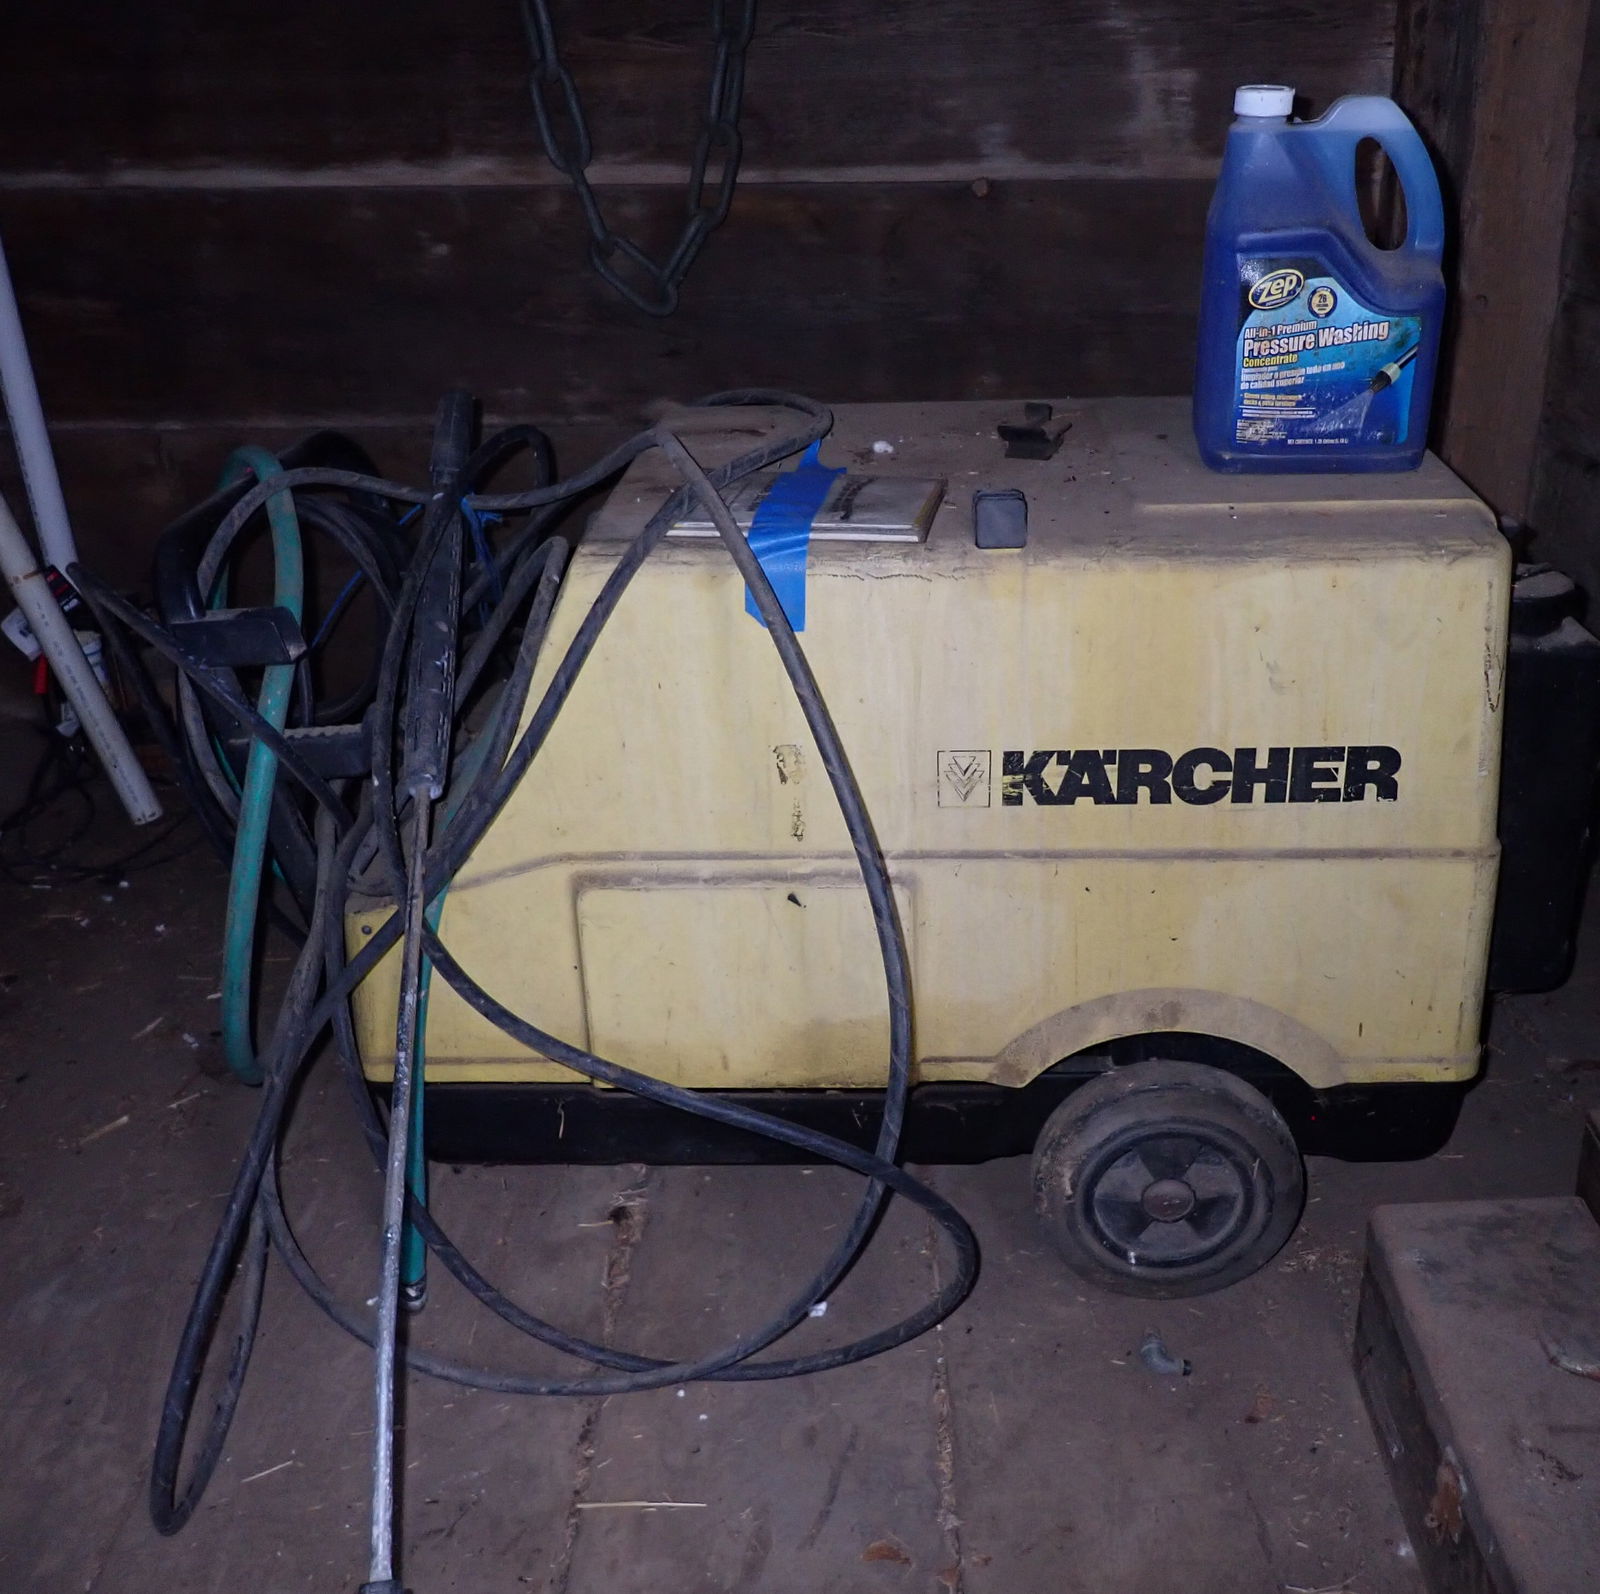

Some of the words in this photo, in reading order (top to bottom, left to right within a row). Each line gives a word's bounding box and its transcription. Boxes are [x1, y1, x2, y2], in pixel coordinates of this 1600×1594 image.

[1243, 333, 1316, 357] Pressure
[1318, 321, 1390, 348] Washing
[1244, 325, 1276, 339] All-in-1
[1276, 320, 1317, 336] Premium
[1243, 353, 1298, 368] Concentrate
[1001, 745, 1402, 806] KÄRCHER
